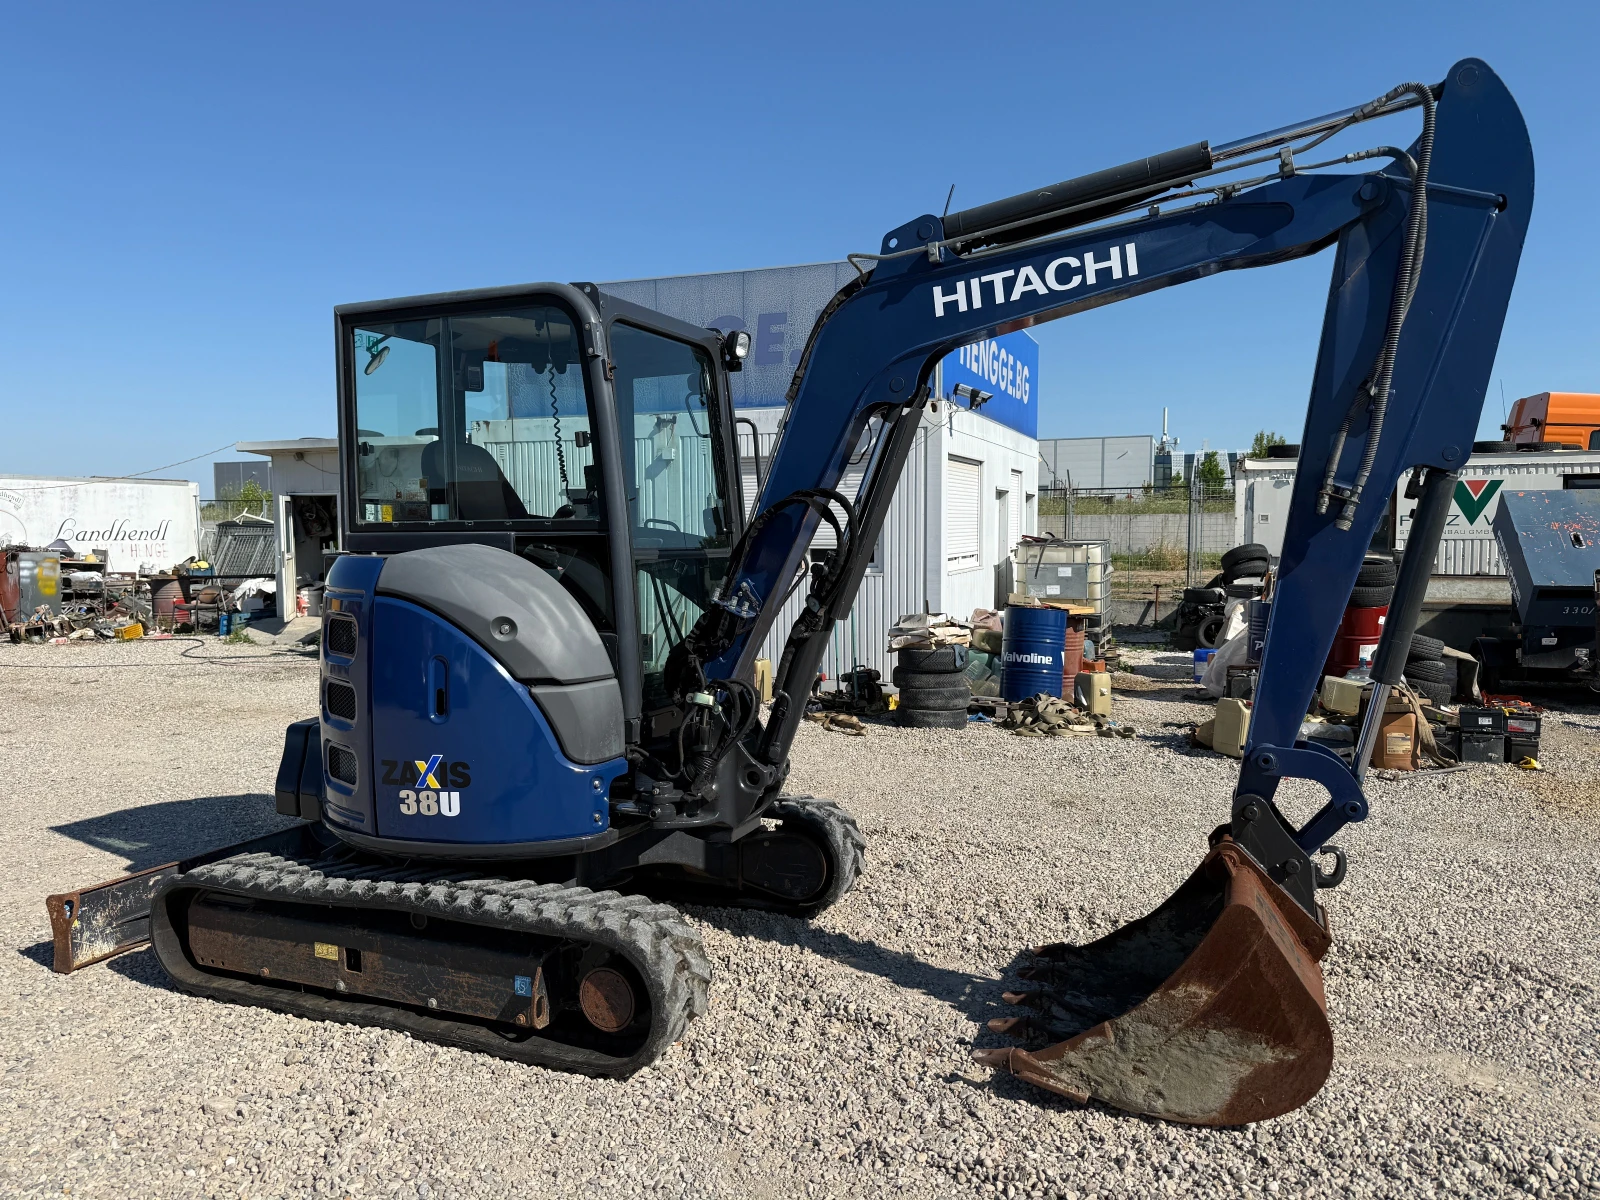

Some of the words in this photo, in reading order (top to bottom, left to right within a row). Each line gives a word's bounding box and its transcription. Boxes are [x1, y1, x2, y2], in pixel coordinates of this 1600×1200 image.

[932, 242, 1139, 318] HITACHI
[55, 518, 172, 542] Landhendl
[381, 754, 472, 789] ZAXIS
[398, 789, 461, 817] 38U
